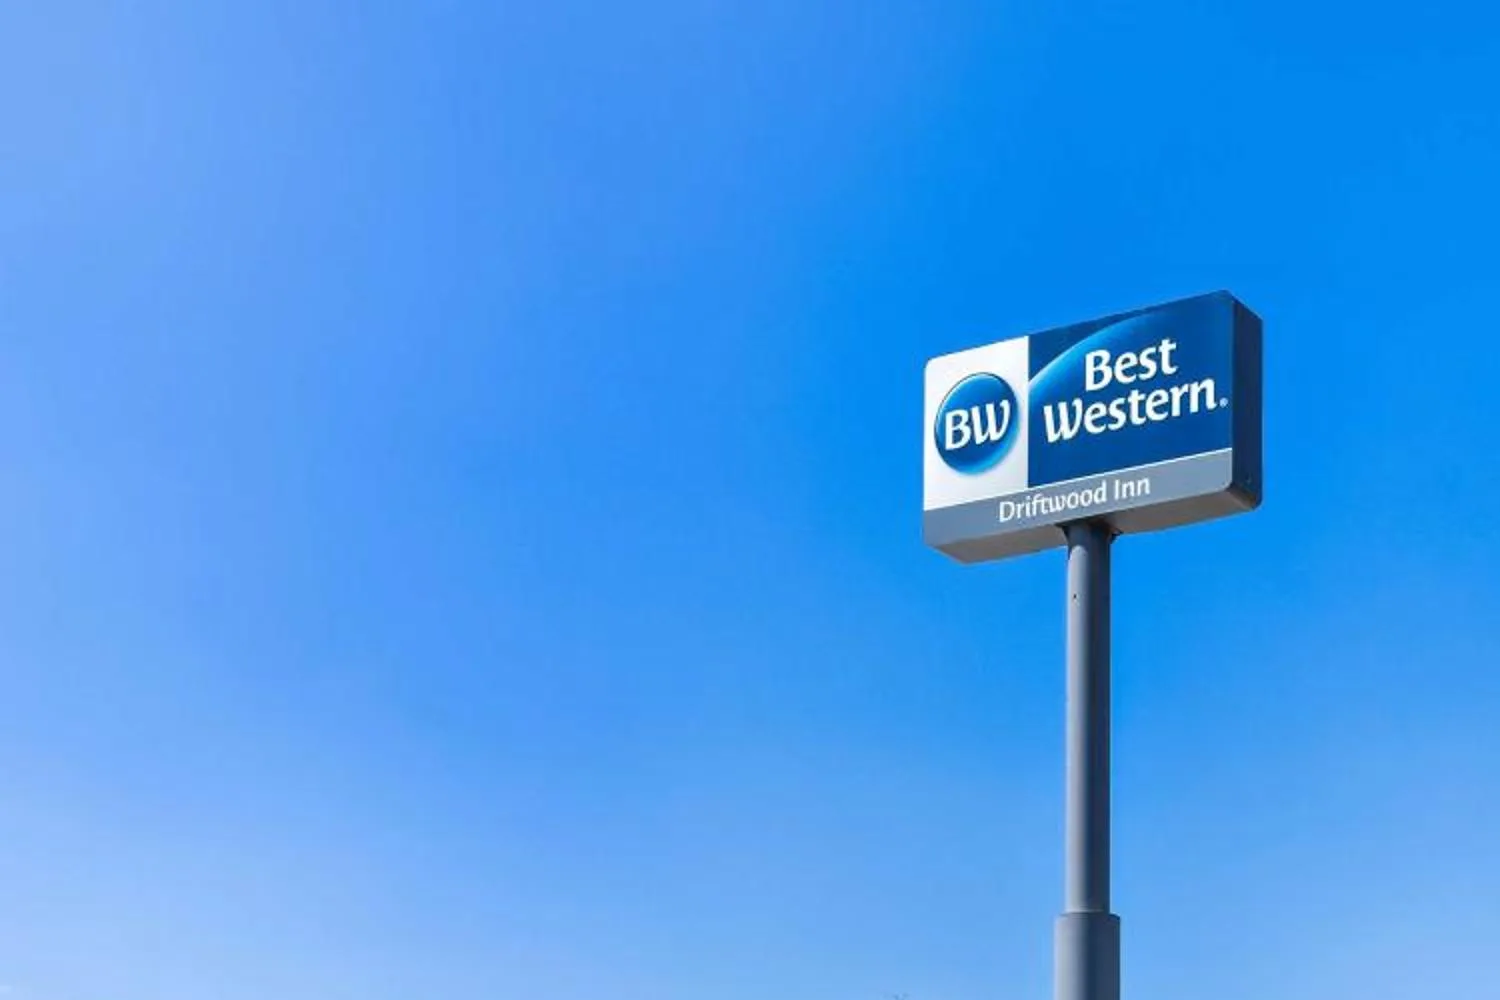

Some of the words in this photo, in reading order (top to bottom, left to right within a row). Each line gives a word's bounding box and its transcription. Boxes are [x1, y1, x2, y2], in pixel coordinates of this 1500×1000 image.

[1085, 338, 1178, 392] Best
[945, 399, 1011, 451] BW
[999, 480, 1108, 523] Driftwood
[1114, 477, 1151, 501] Inn
